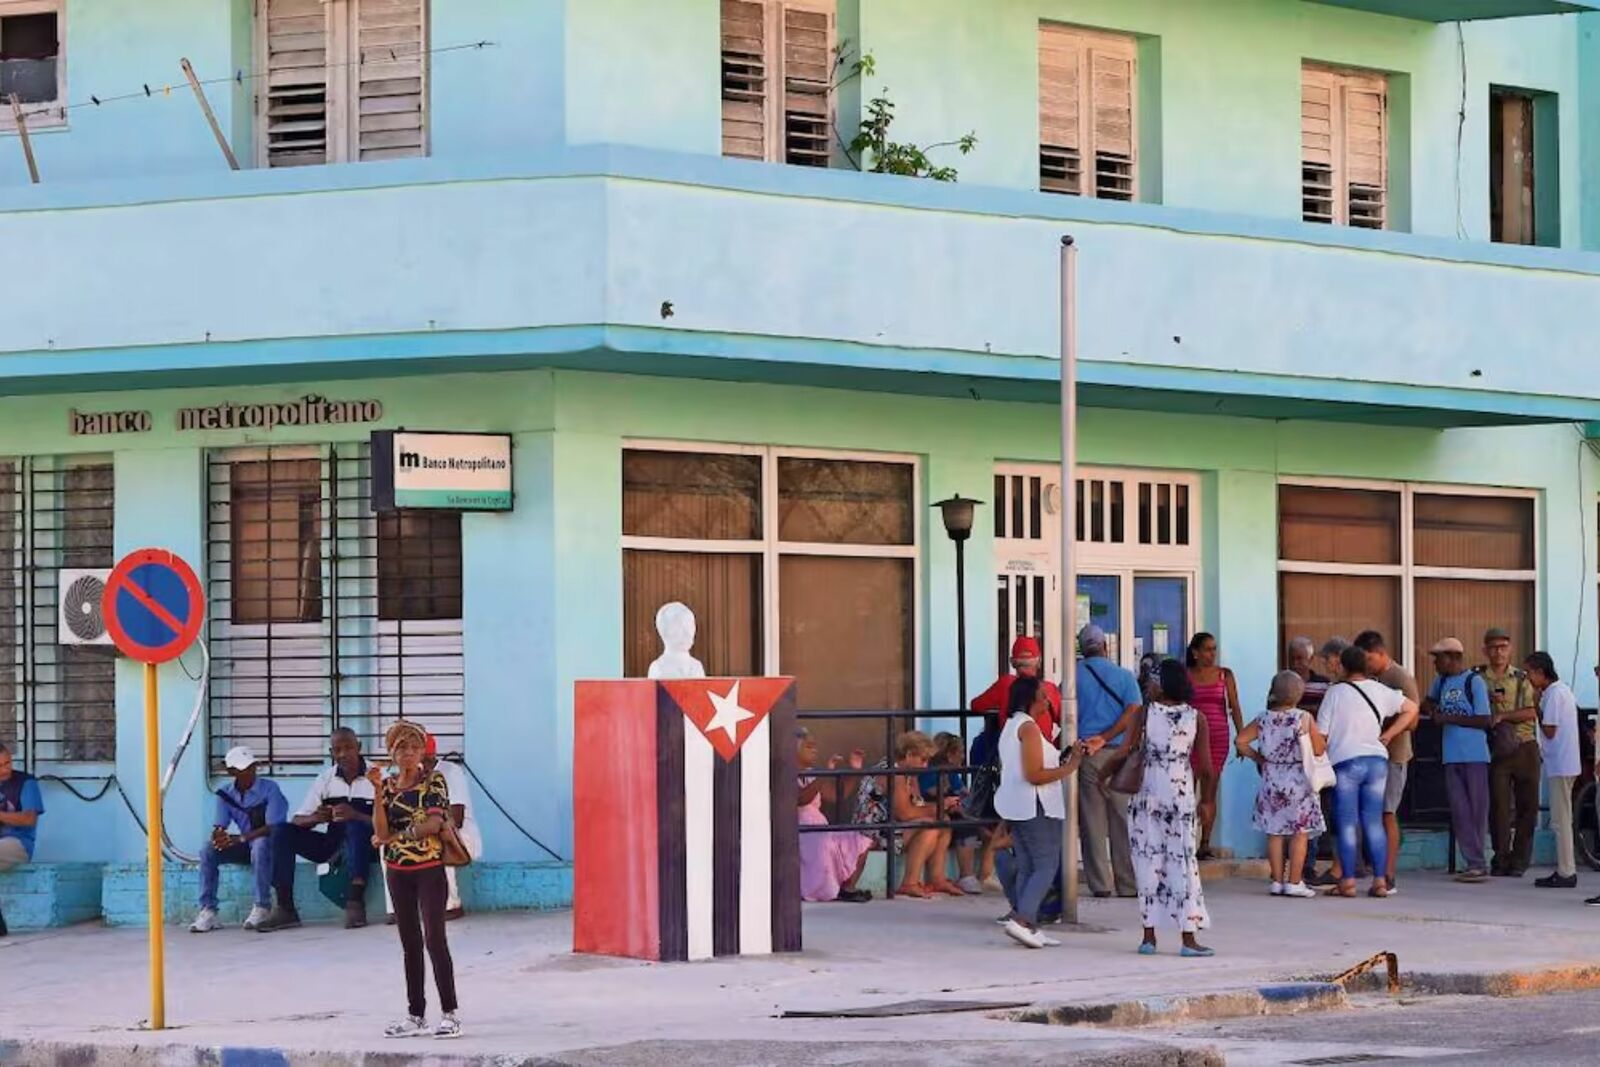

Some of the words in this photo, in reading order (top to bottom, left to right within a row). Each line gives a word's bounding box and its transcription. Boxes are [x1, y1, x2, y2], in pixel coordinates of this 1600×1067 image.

[69, 408, 152, 436] banco
[175, 393, 383, 433] metropolitano
[422, 456, 447, 469] Banco
[448, 456, 506, 473] Metropolitano
